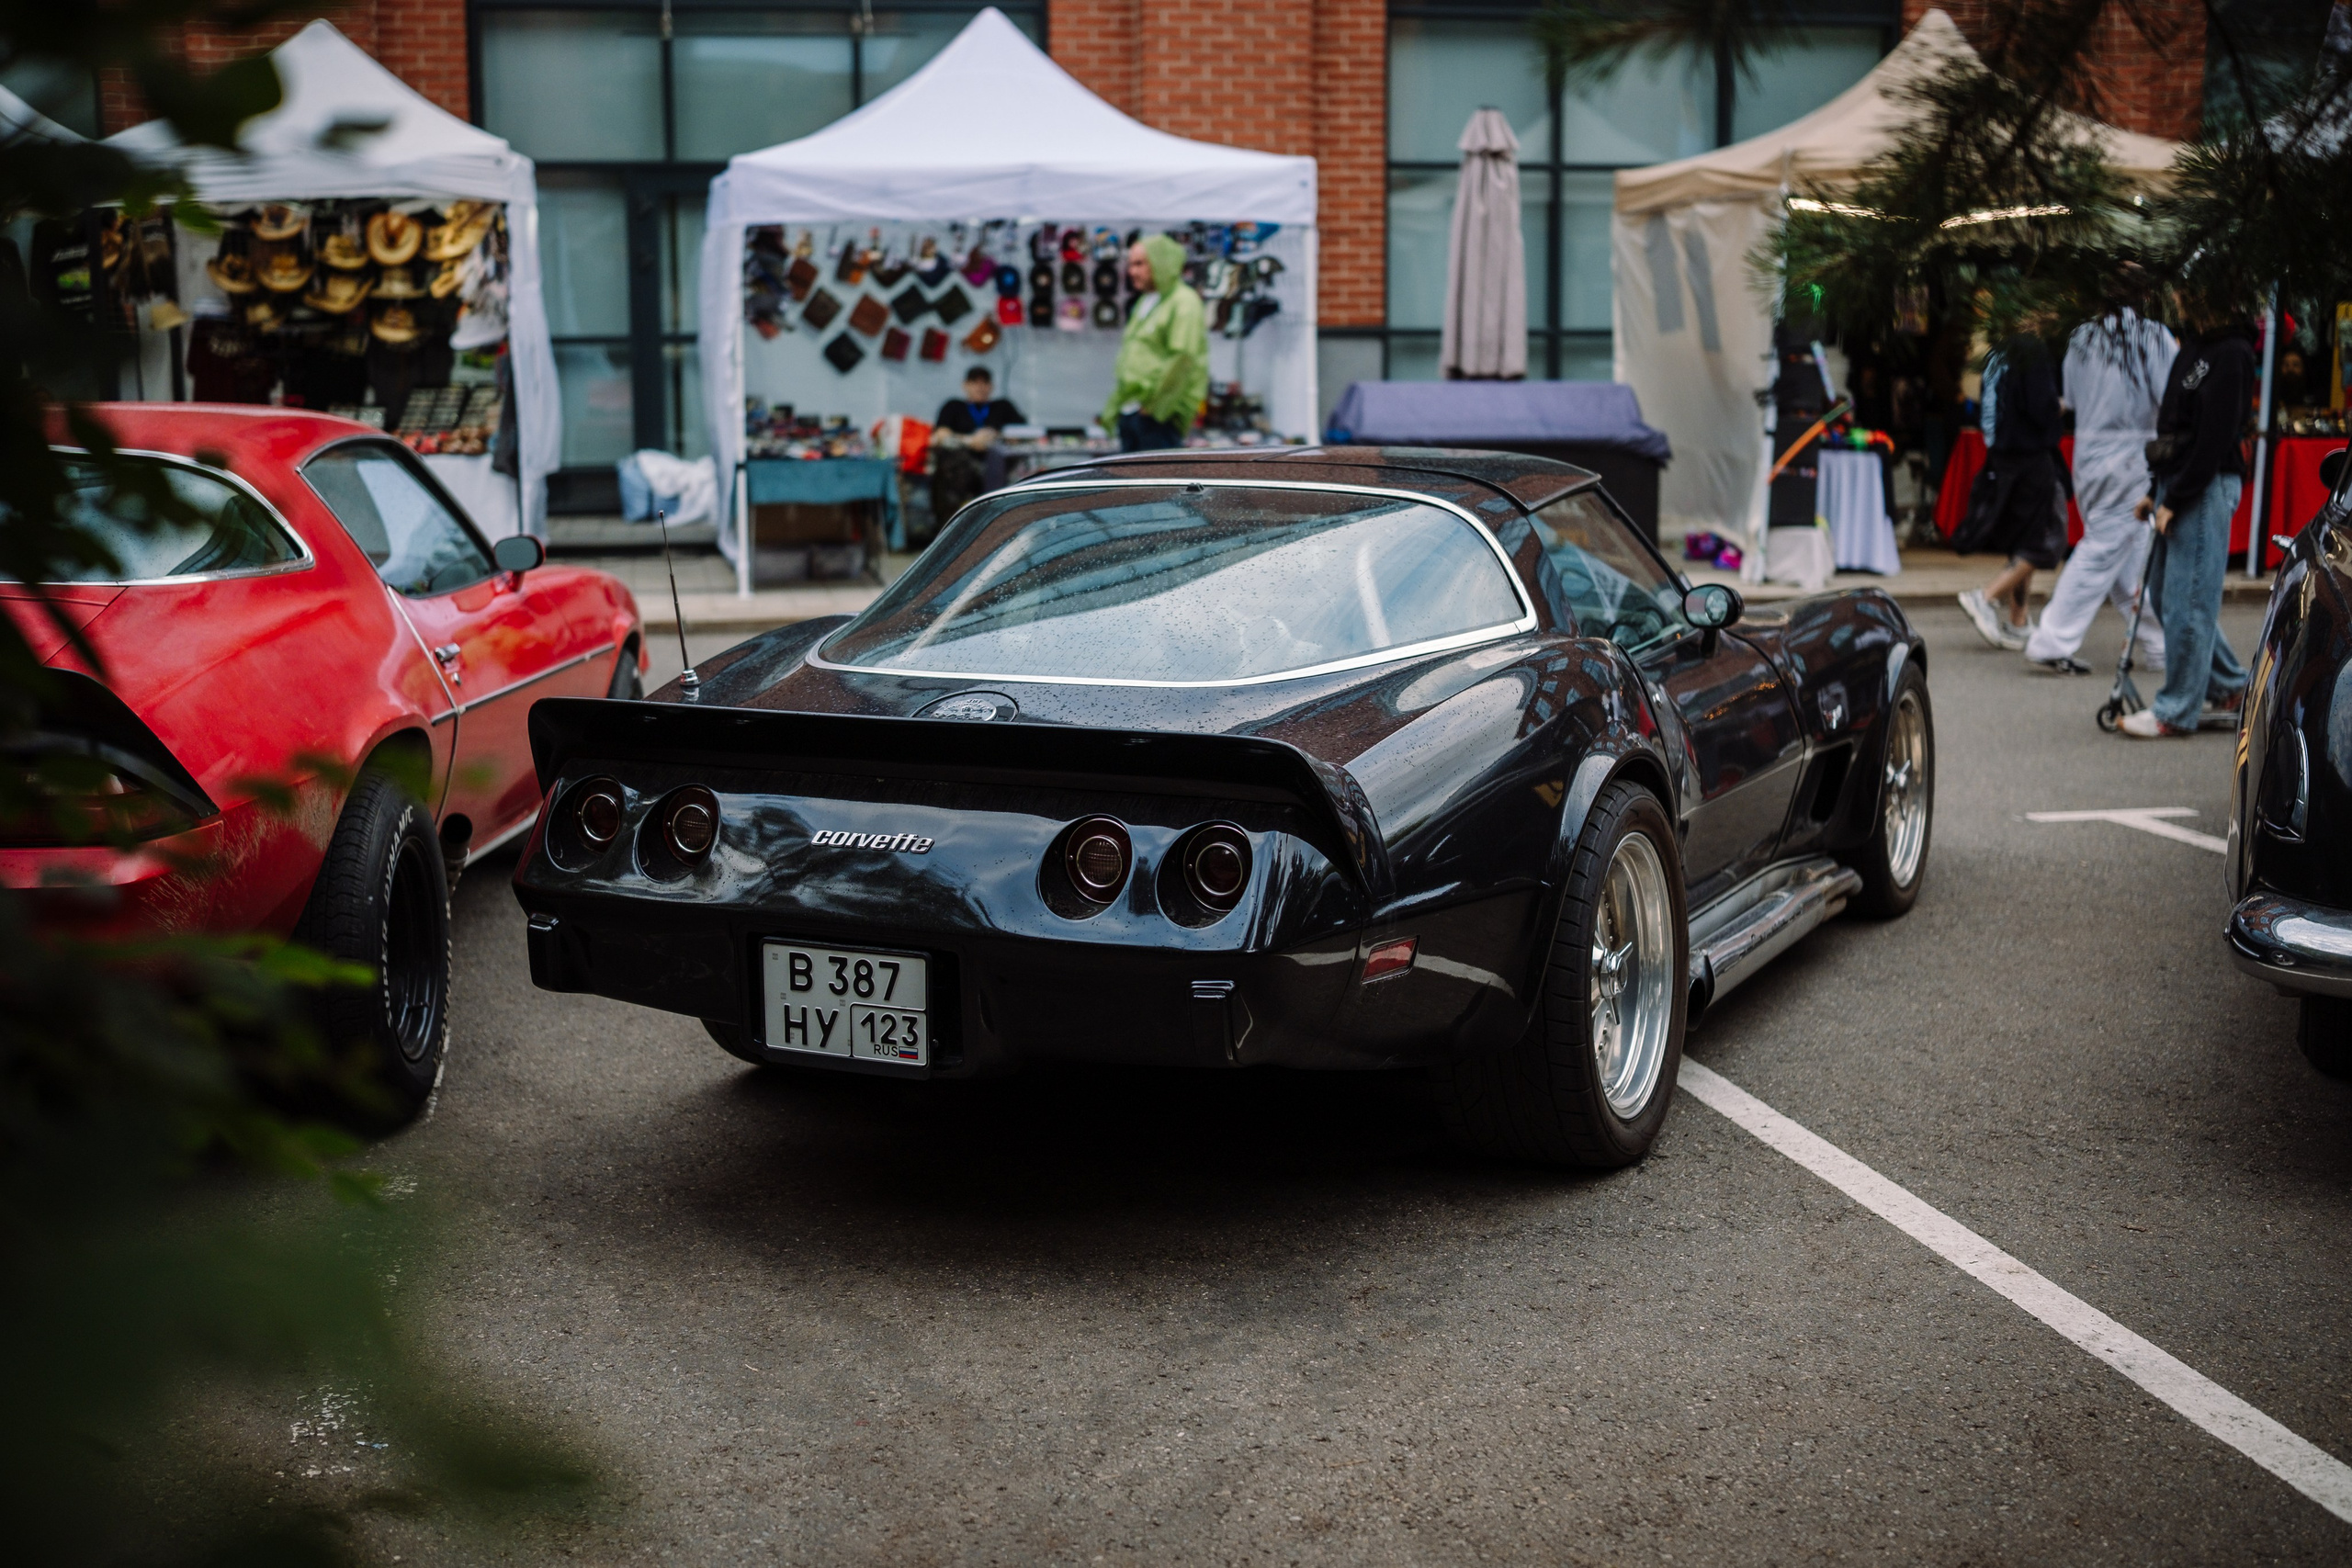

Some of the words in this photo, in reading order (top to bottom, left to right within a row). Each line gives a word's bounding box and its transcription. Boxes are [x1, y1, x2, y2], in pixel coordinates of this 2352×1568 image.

[384, 805, 413, 906] DYNAMIC
[810, 829, 934, 854] corvette
[381, 919, 392, 1028] SUPER
[828, 955, 900, 1001] 387
[860, 1011, 919, 1046] 123
[874, 1044, 899, 1057] RUS
